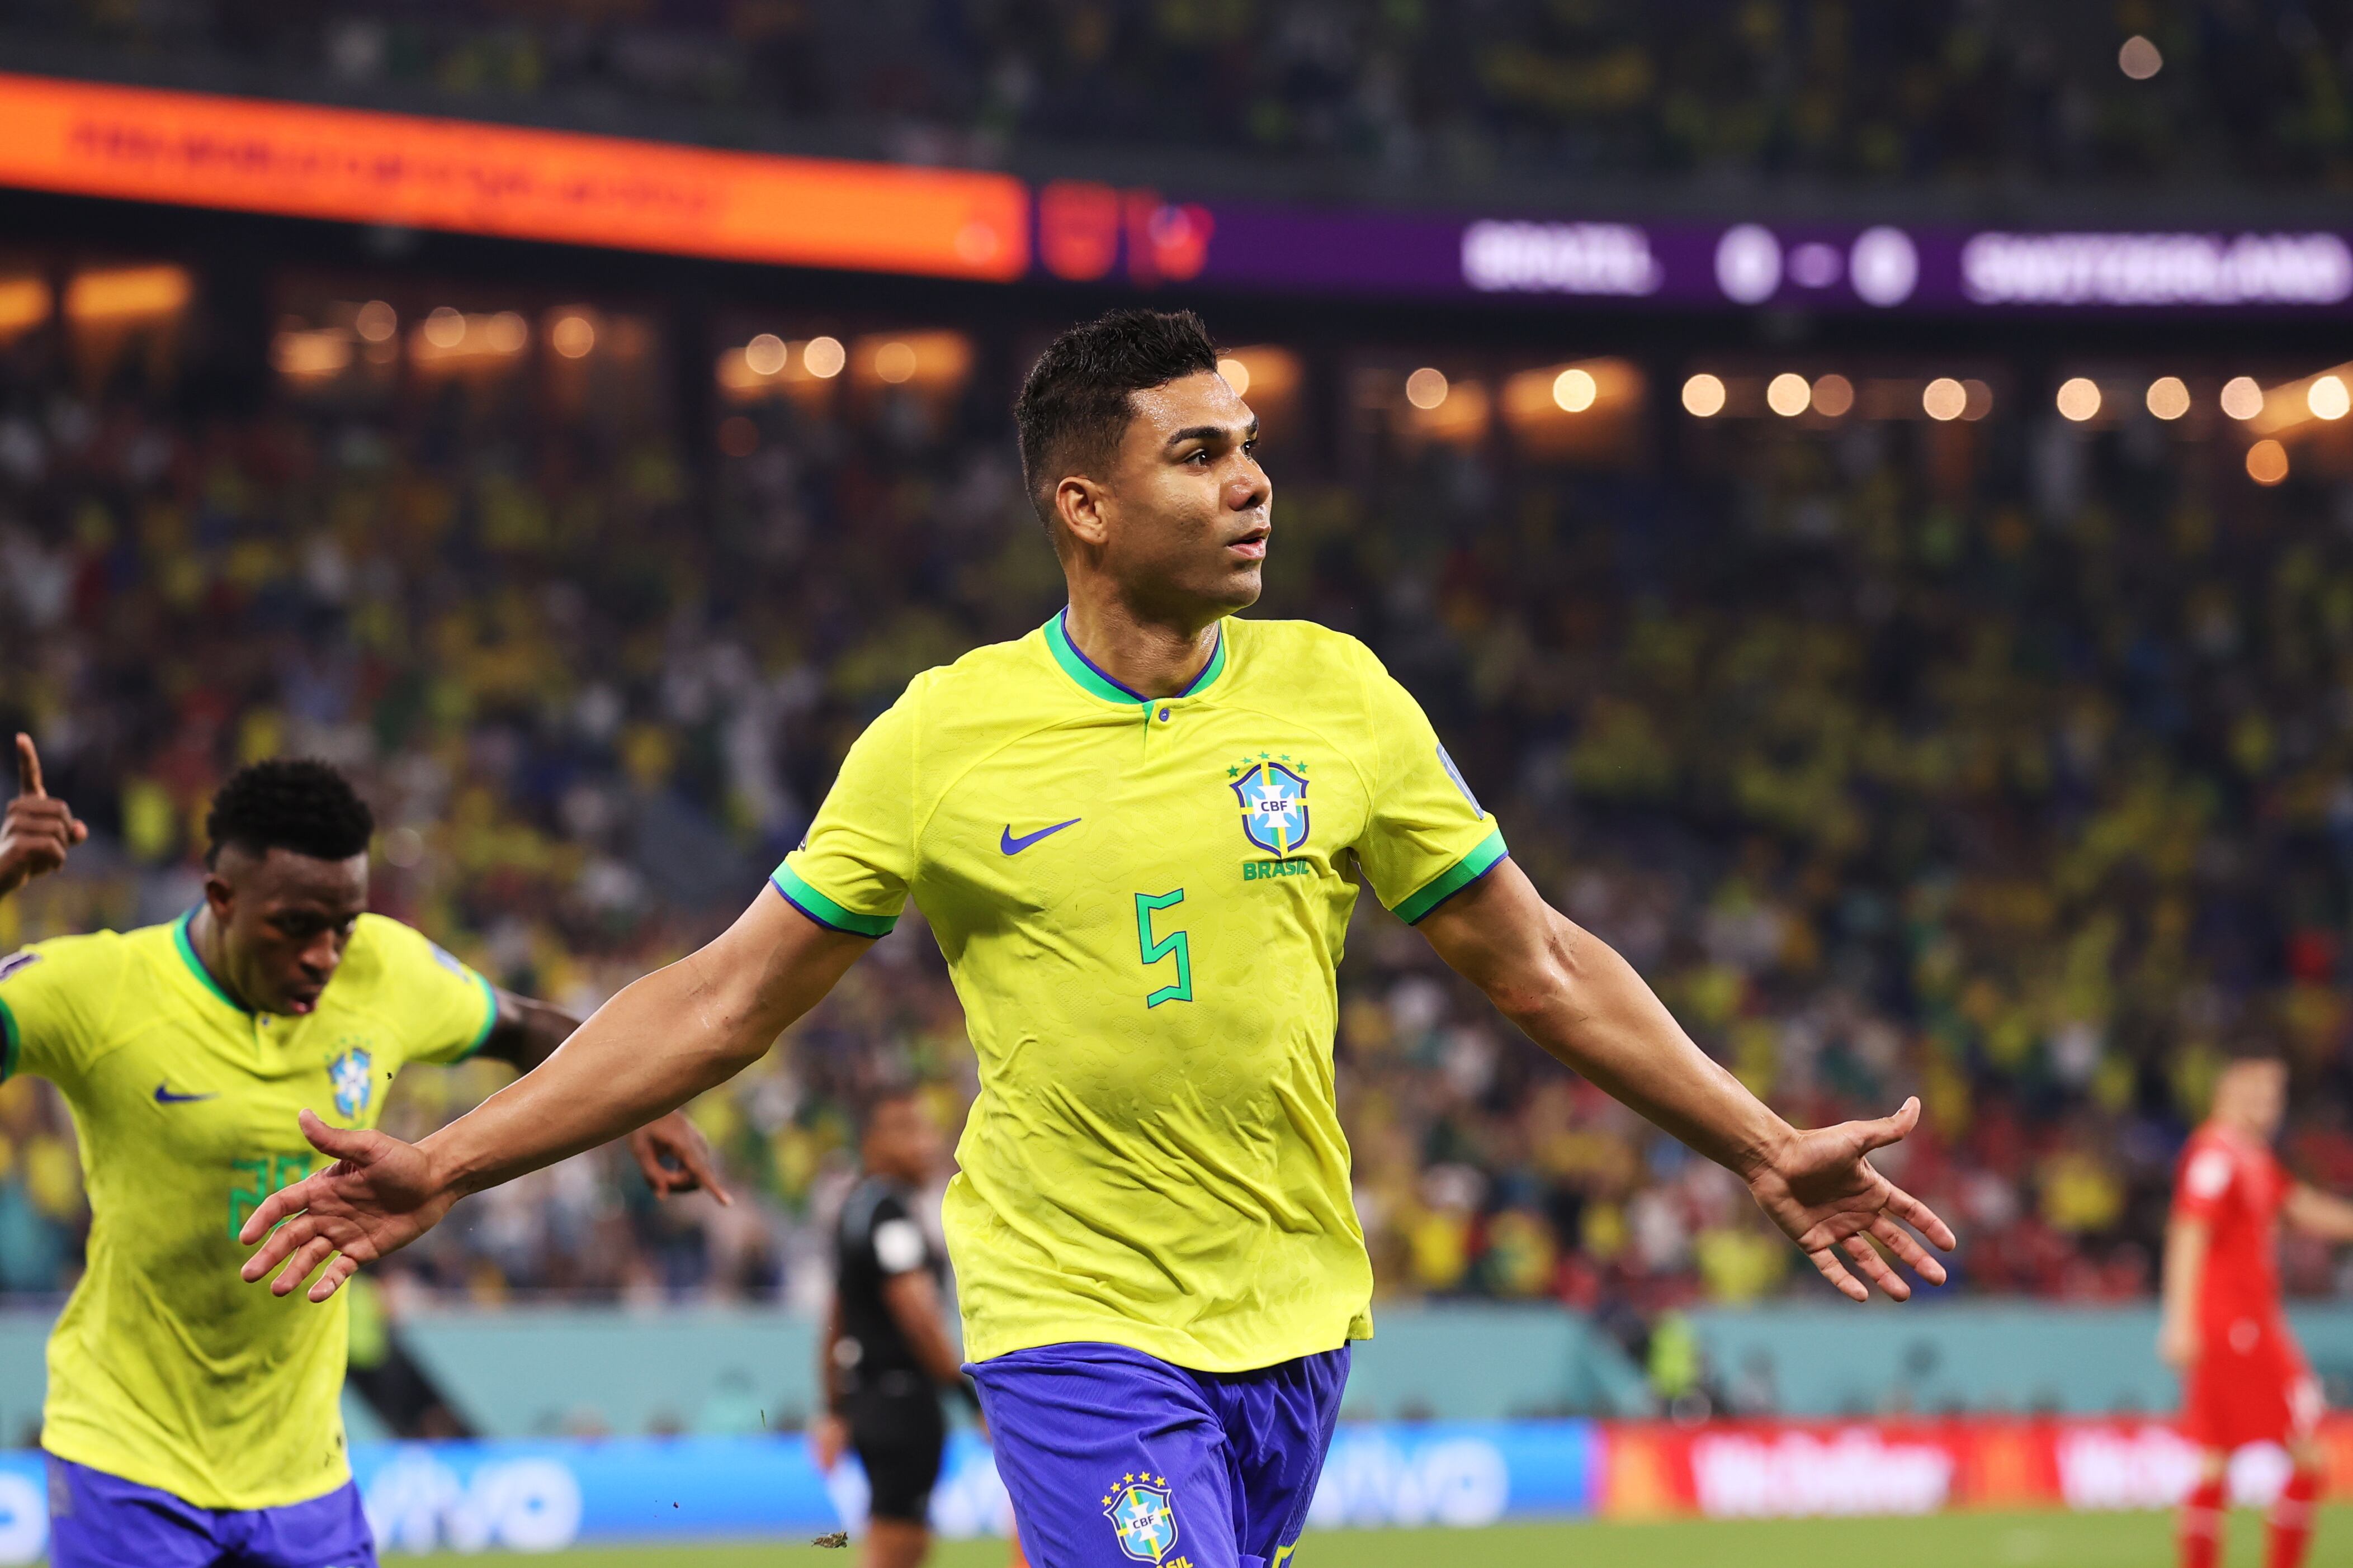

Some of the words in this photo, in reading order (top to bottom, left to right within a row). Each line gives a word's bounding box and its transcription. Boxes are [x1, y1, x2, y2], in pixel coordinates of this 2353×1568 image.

[1261, 800, 1287, 812] CBF
[1244, 858, 1310, 881] BRASIL
[1135, 888, 1193, 1009] 5
[1133, 1514, 1154, 1529] CBF
